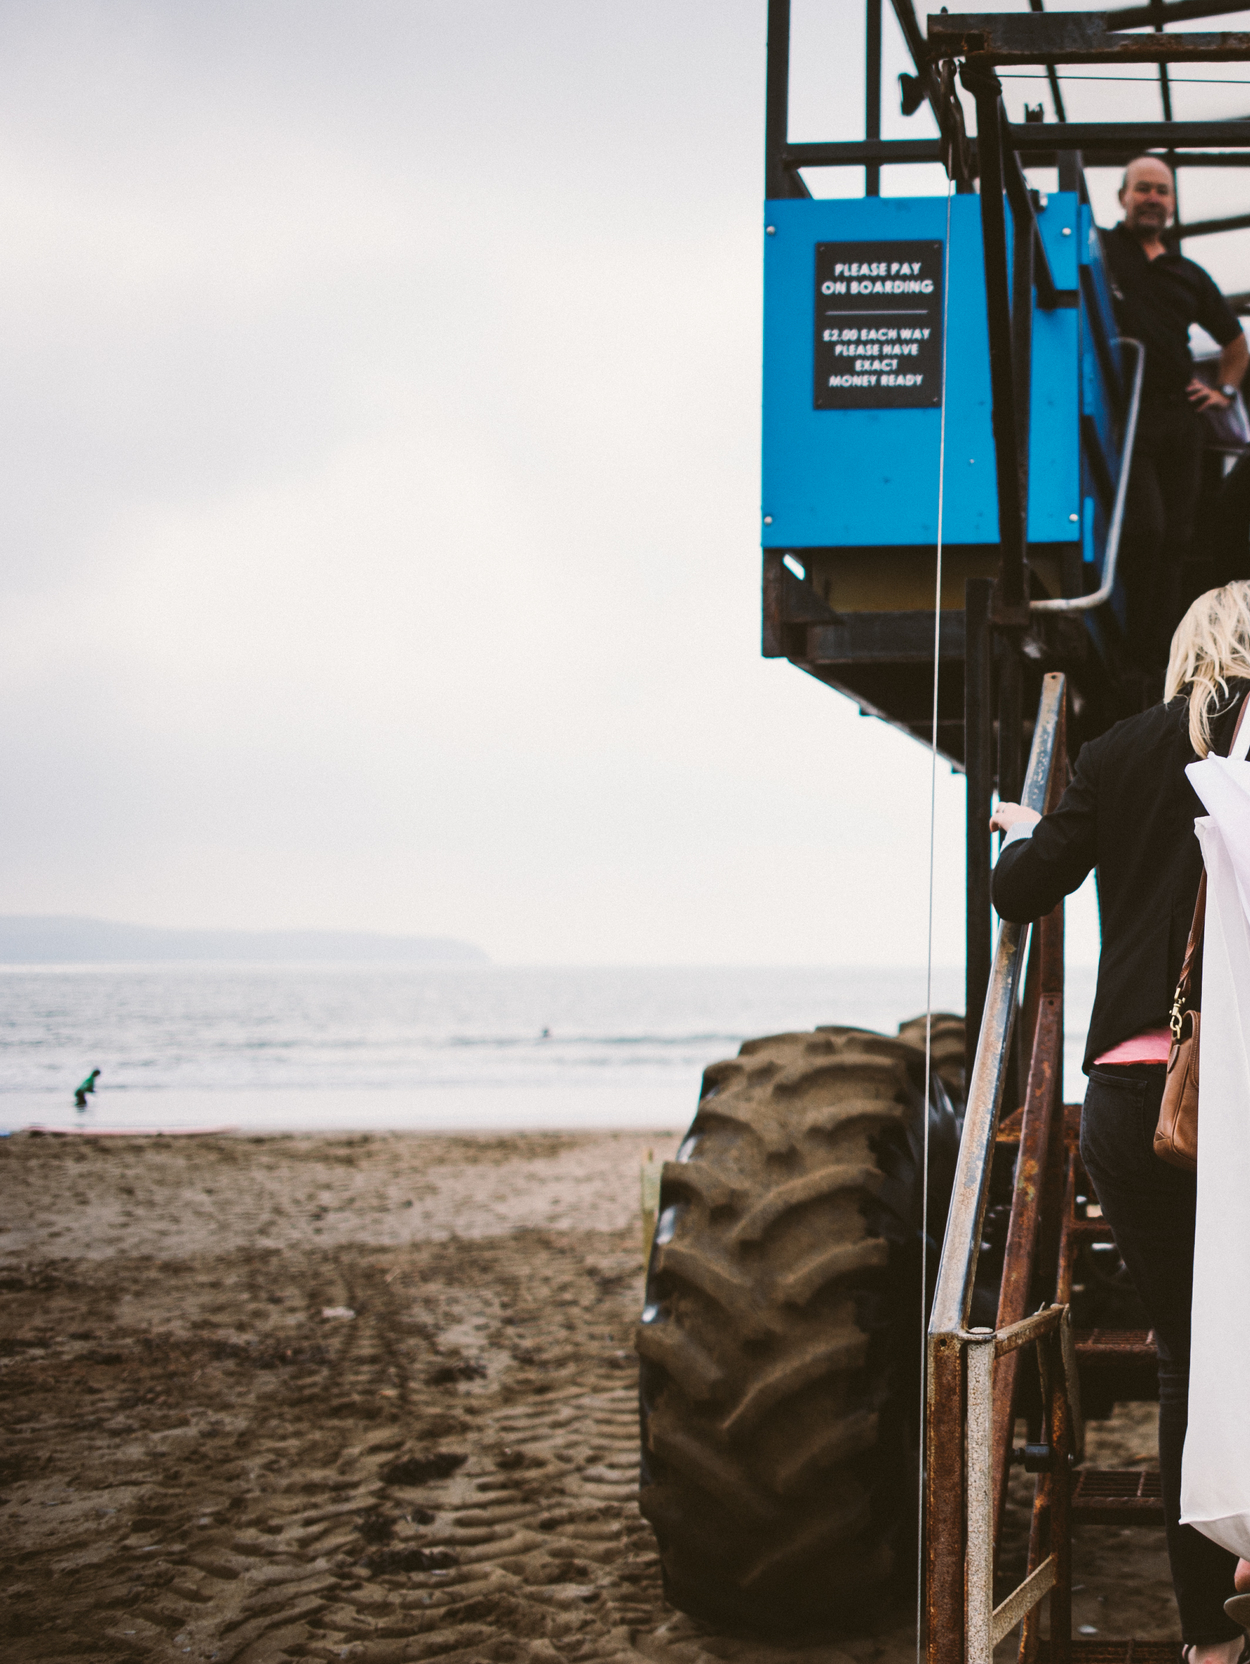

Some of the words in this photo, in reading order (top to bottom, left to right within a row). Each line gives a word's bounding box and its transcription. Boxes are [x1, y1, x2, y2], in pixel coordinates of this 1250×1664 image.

[834, 263, 888, 277] PLEASE
[891, 262, 921, 276] PAY
[821, 281, 847, 295] ON
[850, 280, 934, 295] BOARDING
[860, 328, 897, 341] EACH
[899, 328, 931, 340] WAY
[835, 344, 880, 356] PLEASE
[882, 343, 919, 356] HAVE
[855, 359, 898, 371] EXACT
[828, 375, 877, 388] MONEY
[880, 374, 923, 387] READY
